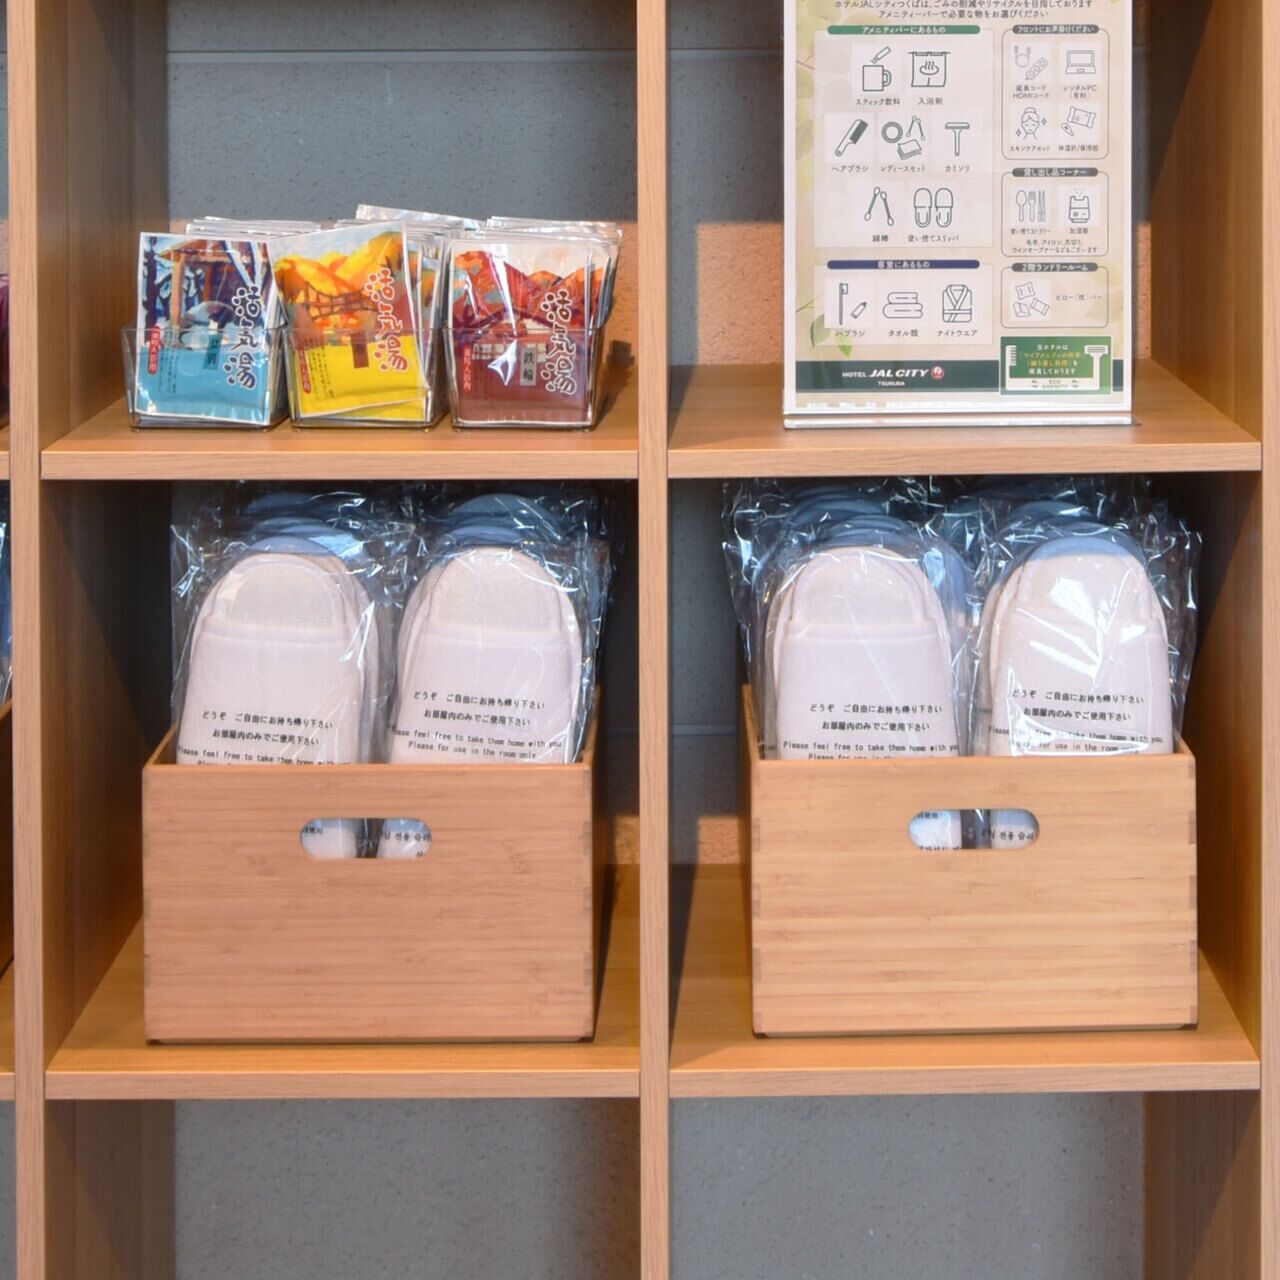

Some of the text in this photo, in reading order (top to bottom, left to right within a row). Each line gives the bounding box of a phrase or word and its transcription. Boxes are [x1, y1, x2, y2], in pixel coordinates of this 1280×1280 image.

[918, 97, 943, 106] 入浴剤
[868, 368, 894, 378] JAL
[895, 368, 930, 378] CITY
[413, 691, 545, 710] どうぞ ご自由にお持ち帰り下さい
[1045, 691, 1144, 704] ご自由にお持ち帰り下さい
[810, 703, 942, 715] どうぞ ご自由にお持ち帰り下さい
[1024, 707, 1131, 721] お部屋内のみでご使用下さい
[202, 710, 333, 730] どうぞ ご自由にお持ち帰り下さい
[424, 709, 531, 727] お部屋内のみでご使用下さい
[822, 721, 930, 732] お部屋内のみでご使用下さい
[414, 729, 526, 748] feel free to take them home
[408, 740, 435, 751] Please
[437, 743, 450, 752] for
[453, 746, 467, 754] use
[483, 747, 496, 756] the
[498, 750, 516, 758] room
[783, 740, 926, 752] Please feel free to take them home
[1055, 741, 1098, 751] use in the
[202, 749, 274, 763] feel free to take
